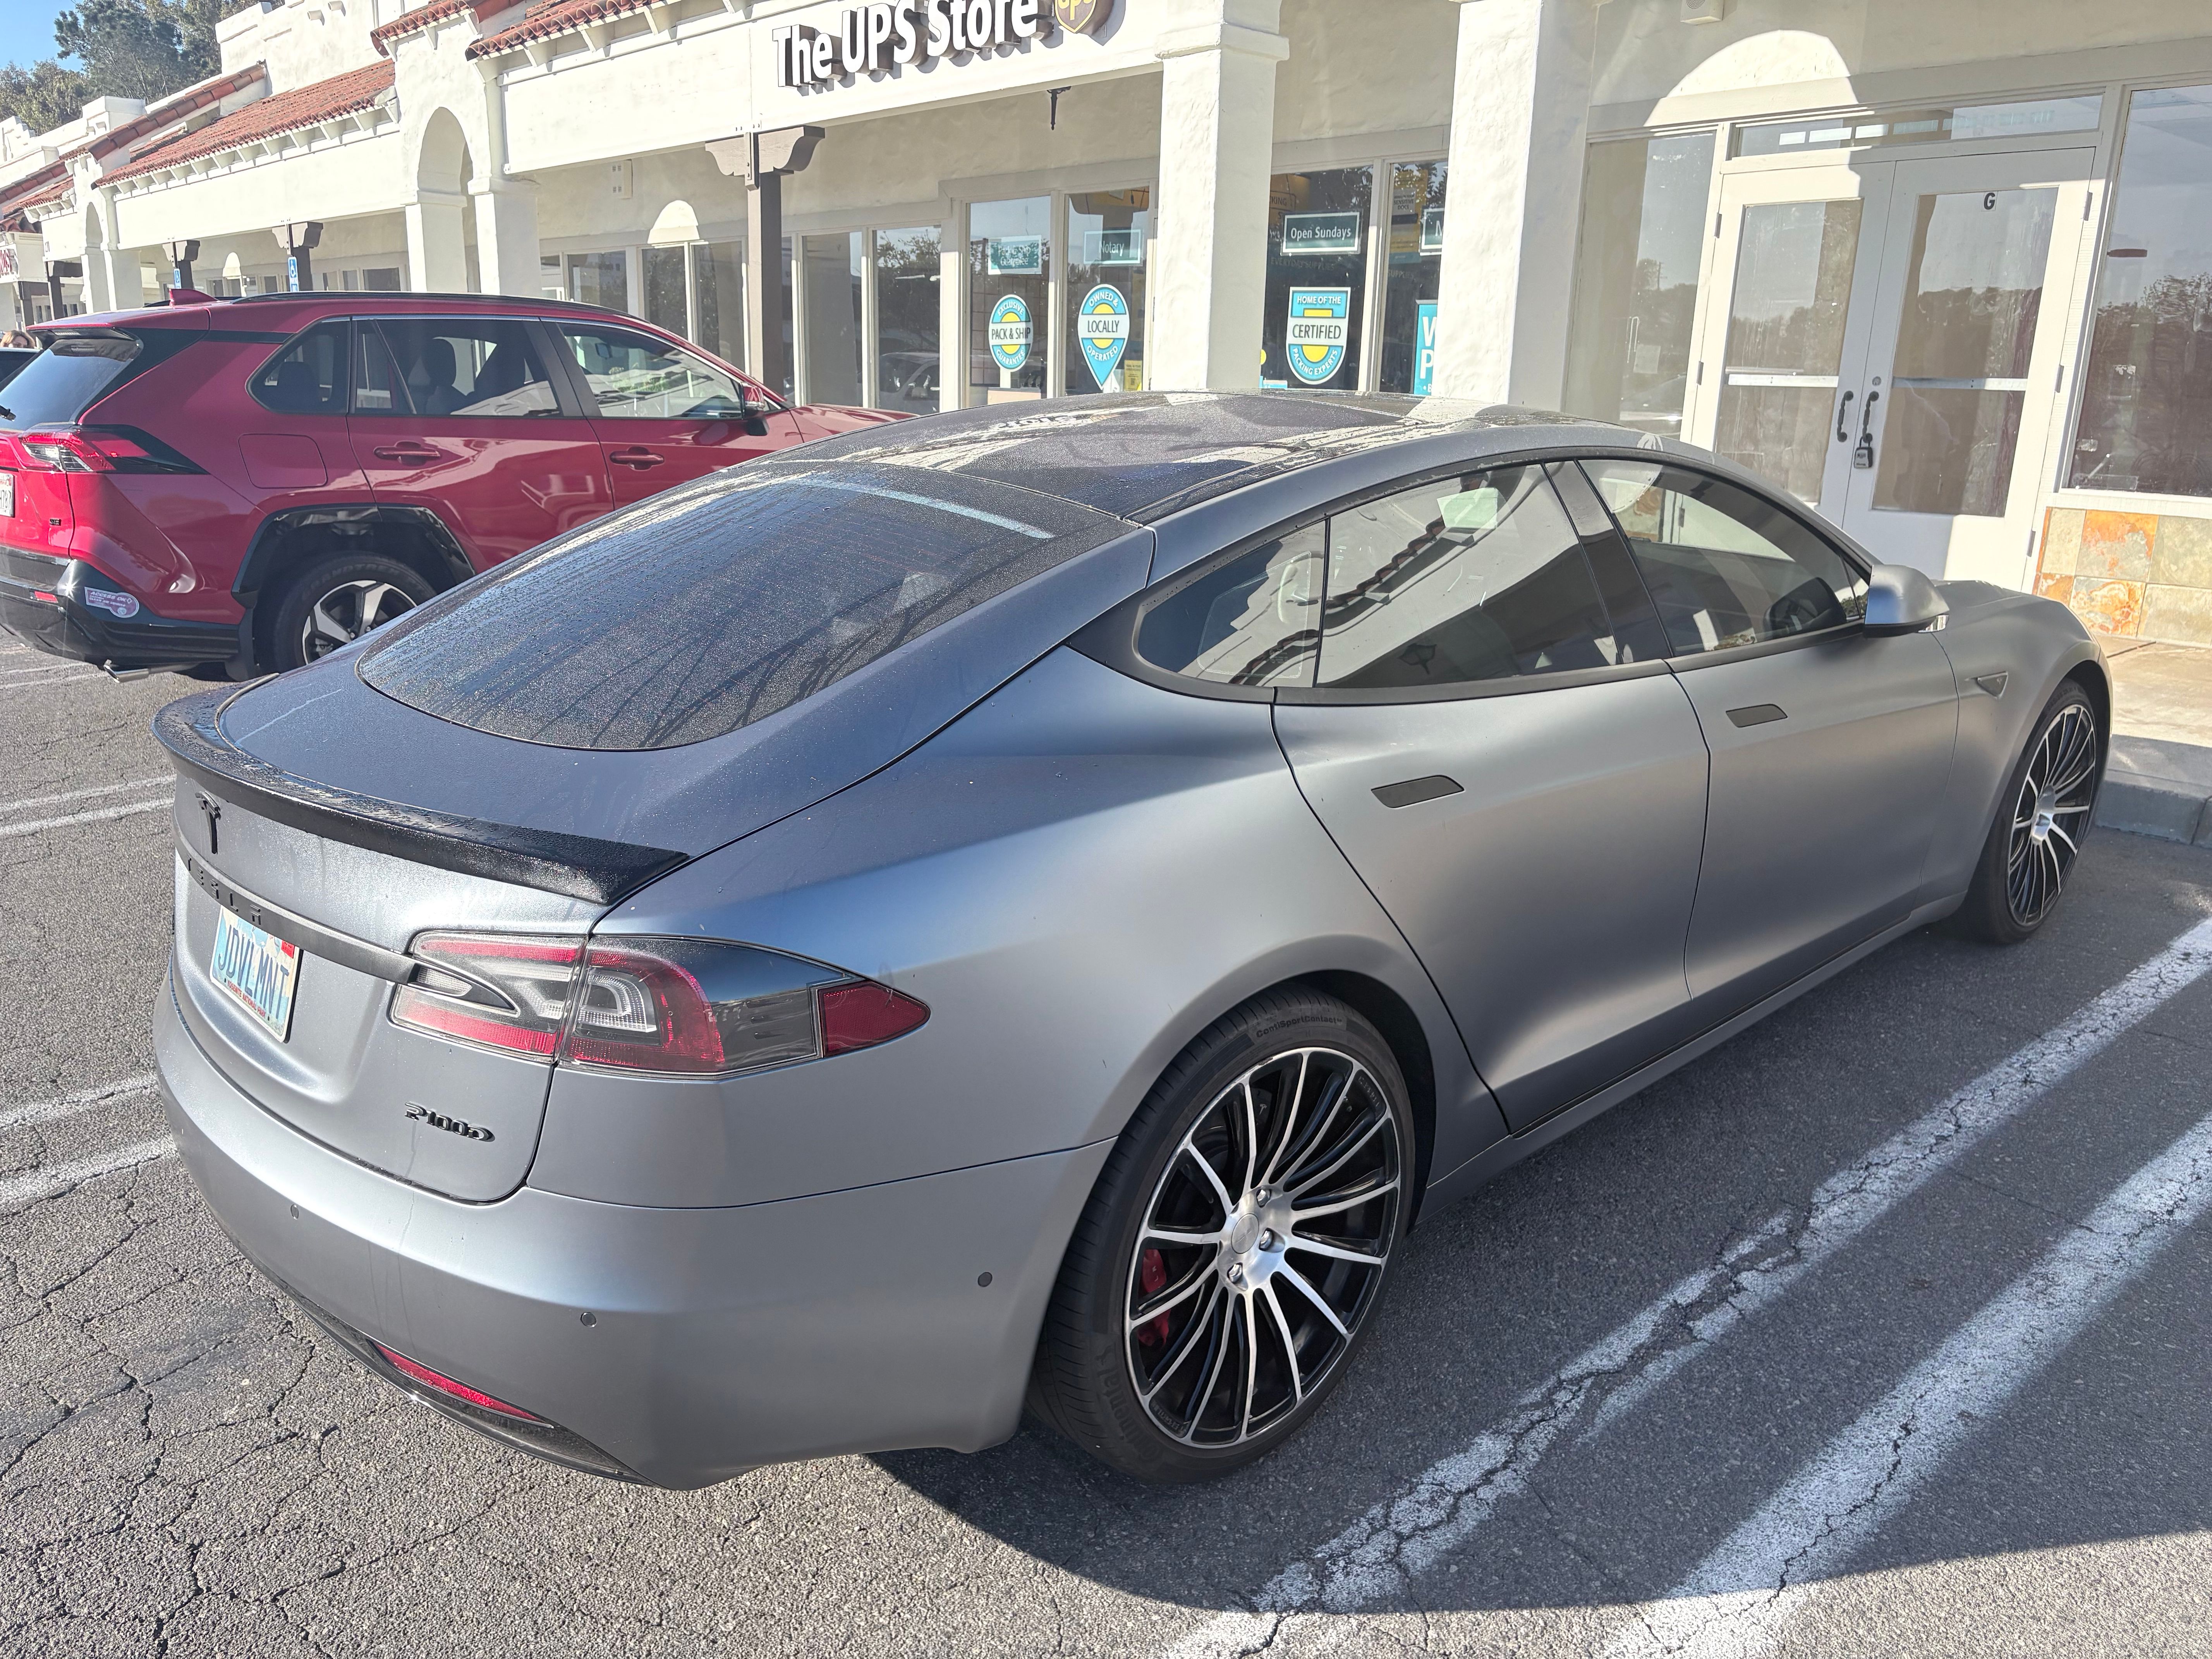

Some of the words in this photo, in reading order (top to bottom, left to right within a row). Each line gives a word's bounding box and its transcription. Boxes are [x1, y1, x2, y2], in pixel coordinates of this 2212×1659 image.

[773, 24, 833, 87] The
[842, 0, 916, 73] UPS
[927, 0, 1038, 57] Store
[1984, 192, 1996, 210] G
[1291, 228, 1312, 241] Open
[1315, 226, 1351, 240] Sundays
[1099, 240, 1124, 256] Notary
[1089, 291, 1113, 307] OWNED
[1113, 298, 1119, 307] &
[1297, 295, 1317, 304] HOME
[1317, 296, 1327, 304] OF
[1328, 296, 1341, 304] THE
[997, 301, 1024, 316] EXCLUSIVE
[991, 328, 1008, 340] PACK
[1009, 328, 1013, 340] &
[1015, 327, 1030, 339] SHIP
[1087, 320, 1120, 333] LOCALLY
[1292, 324, 1341, 339] CERTIFIED
[996, 349, 1025, 366] GUARANTEE
[1087, 345, 1118, 361] OPERATED
[1292, 347, 1313, 375] PACKING
[1314, 349, 1338, 375] EXPERTS
[90, 591, 115, 599] ACCESS
[187, 854, 262, 925] TESLA
[218, 924, 290, 1020] JDVLMNT
[405, 1102, 495, 1142] P100D
